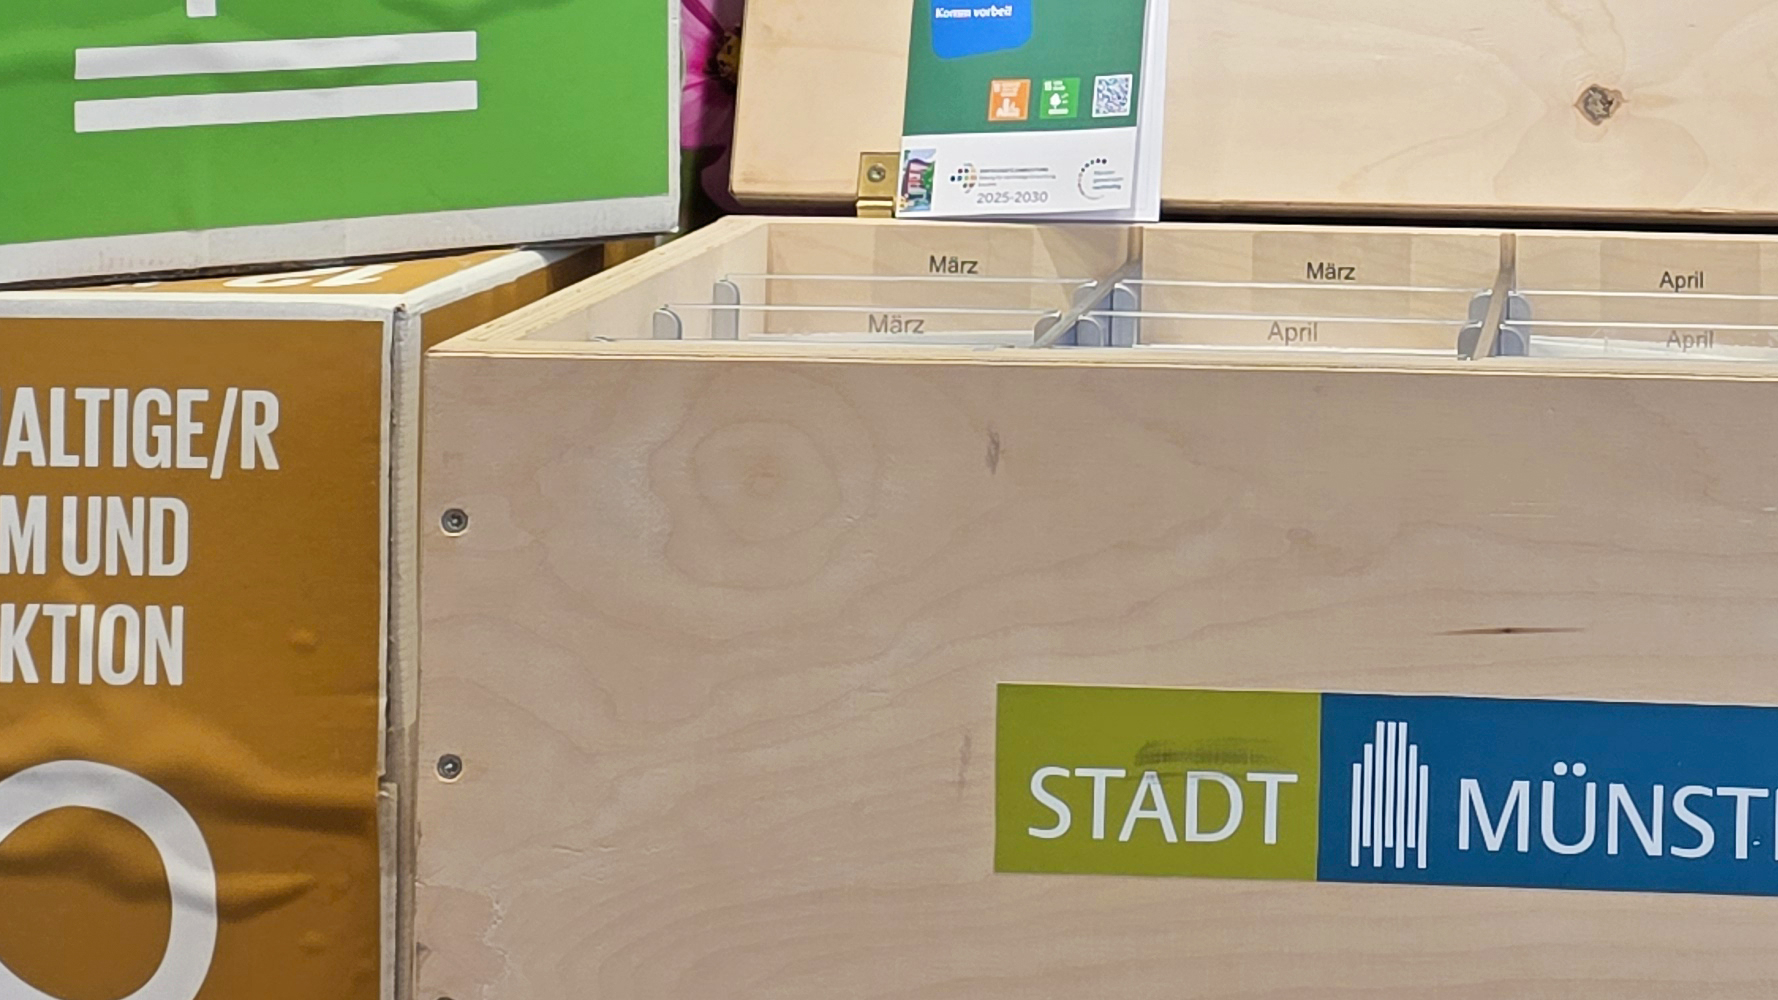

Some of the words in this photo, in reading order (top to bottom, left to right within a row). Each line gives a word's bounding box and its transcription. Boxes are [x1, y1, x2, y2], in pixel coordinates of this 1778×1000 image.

[935, 7, 972, 18] Komm
[976, 191, 1048, 204] 2025-2030
[929, 254, 979, 275] März
[1306, 261, 1356, 281] März
[1659, 270, 1704, 292] April
[868, 313, 925, 335] März
[1267, 320, 1319, 345] April
[1663, 328, 1717, 352] April
[62, 496, 189, 577] UND
[1028, 766, 1299, 845] STADT
